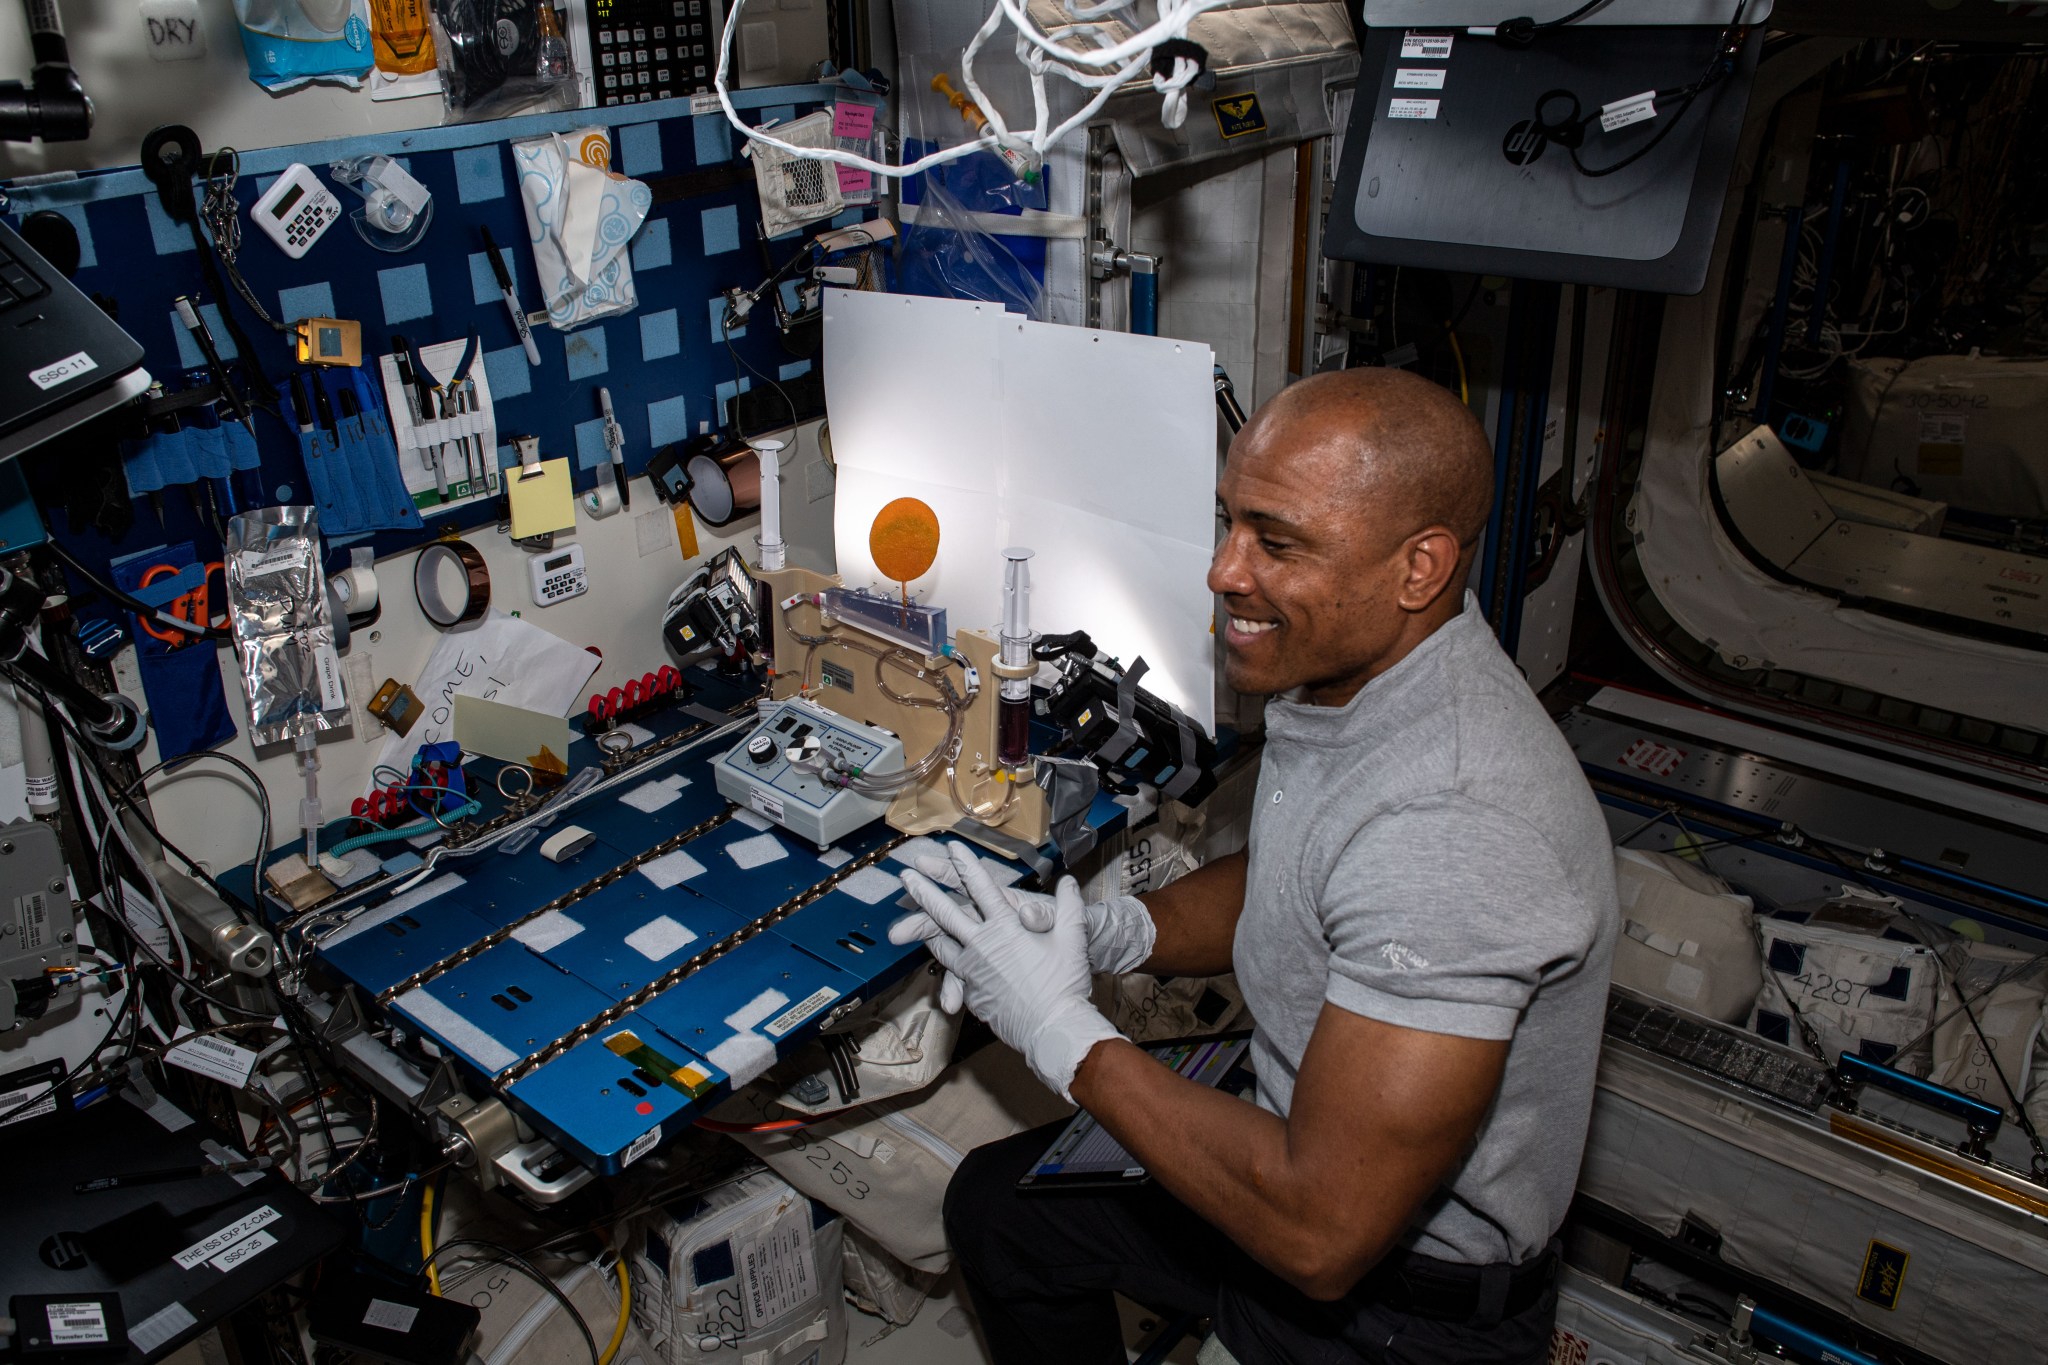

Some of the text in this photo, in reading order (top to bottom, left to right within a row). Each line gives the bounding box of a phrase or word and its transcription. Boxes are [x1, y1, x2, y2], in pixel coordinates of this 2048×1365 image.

[147, 18, 196, 46] DRY
[350, 14, 362, 52] THICKER
[514, 308, 530, 339] Sharpie
[37, 359, 86, 383] SSC 11
[325, 656, 333, 680] Grape
[832, 740, 855, 754] VARIABLE
[836, 736, 862, 750] MINI-PUMP
[806, 992, 822, 1003] STRAP
[1792, 972, 1871, 1009] 4287
[747, 1092, 871, 1201] 1.05253
[180, 1208, 275, 1264] THE ISS EXP Z-CAM
[223, 1239, 263, 1264] SSC-25
[747, 1253, 764, 1318] OFFICE SUPPLIES
[716, 1283, 746, 1350] 4222
